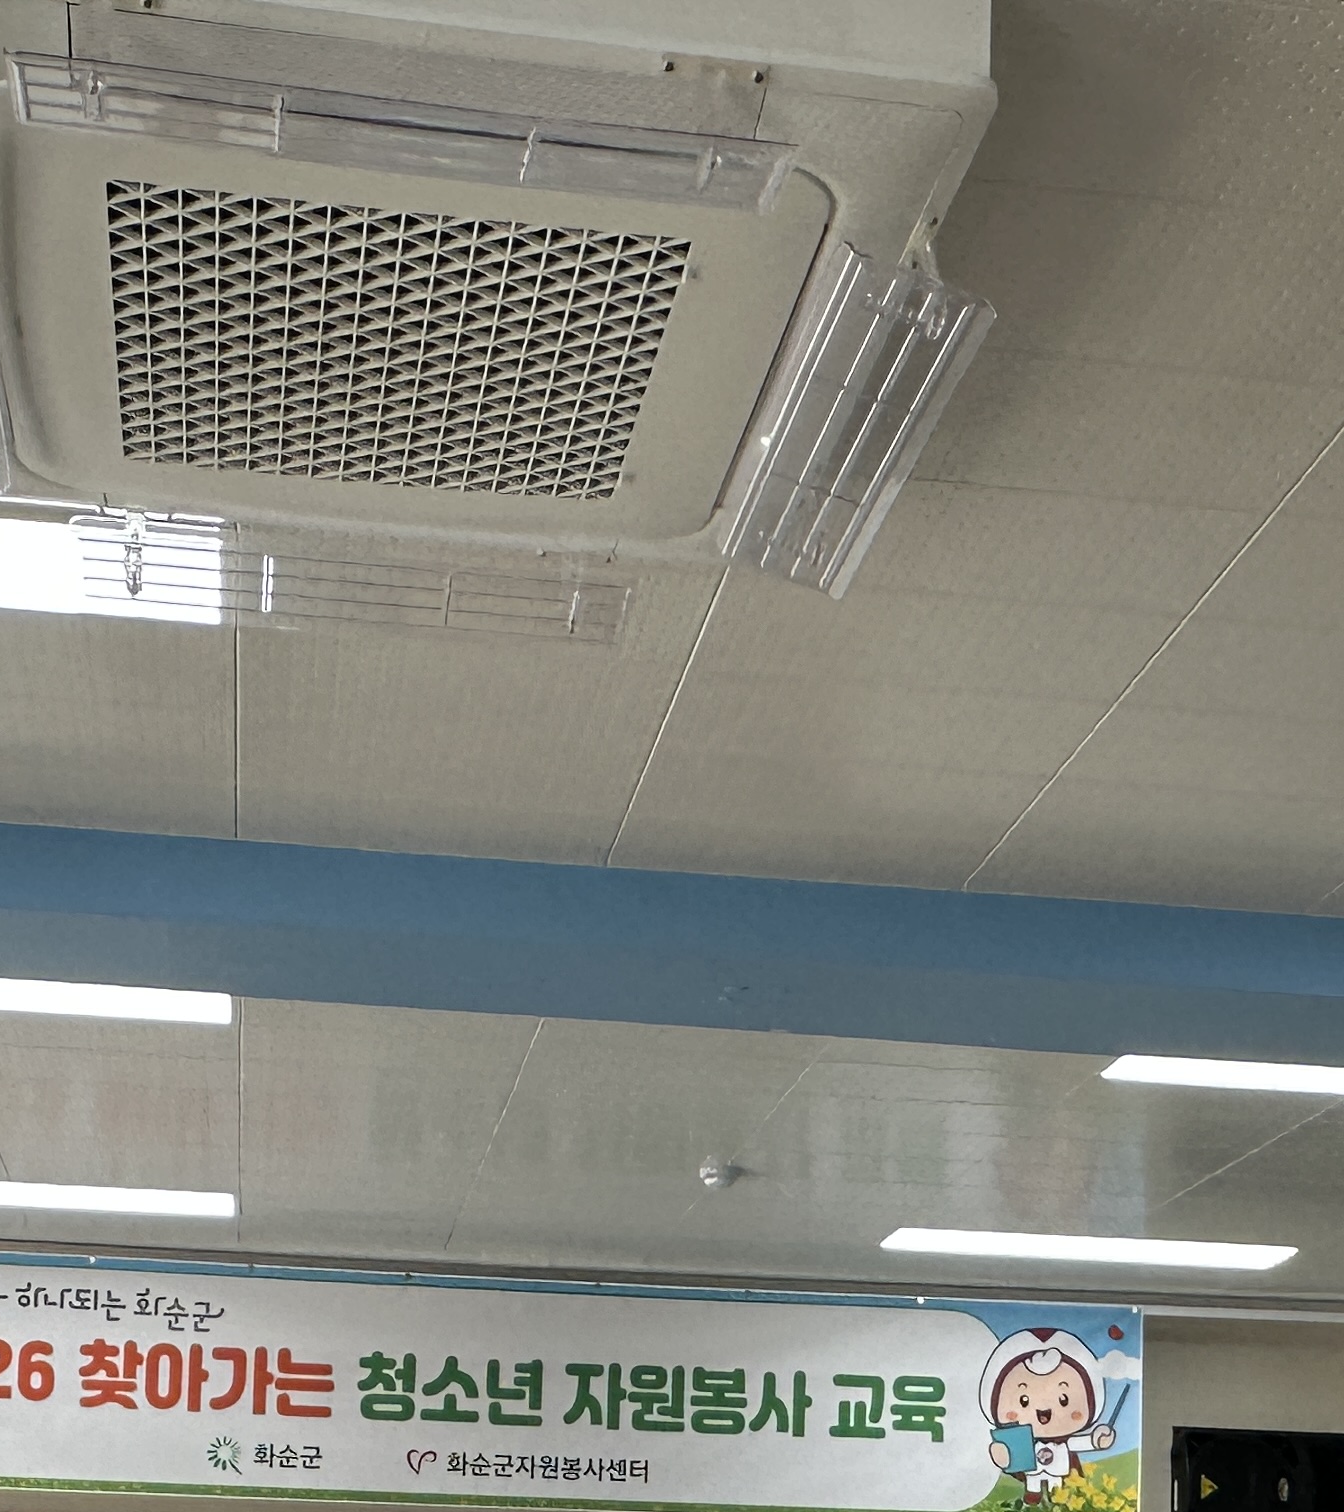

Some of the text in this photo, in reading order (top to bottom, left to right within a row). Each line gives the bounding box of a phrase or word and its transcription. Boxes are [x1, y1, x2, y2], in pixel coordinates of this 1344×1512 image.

[14, 1281, 127, 1322] 하나되는
[133, 1287, 225, 1333] 화순군
[78, 1338, 336, 1419] 찾아가는
[356, 1350, 544, 1428] 청소년
[562, 1362, 814, 1438] 자원봉사
[828, 1373, 947, 1444] 교육
[253, 1443, 323, 1470] 화순군
[446, 1451, 649, 1484] 화순군자원봉사센터
